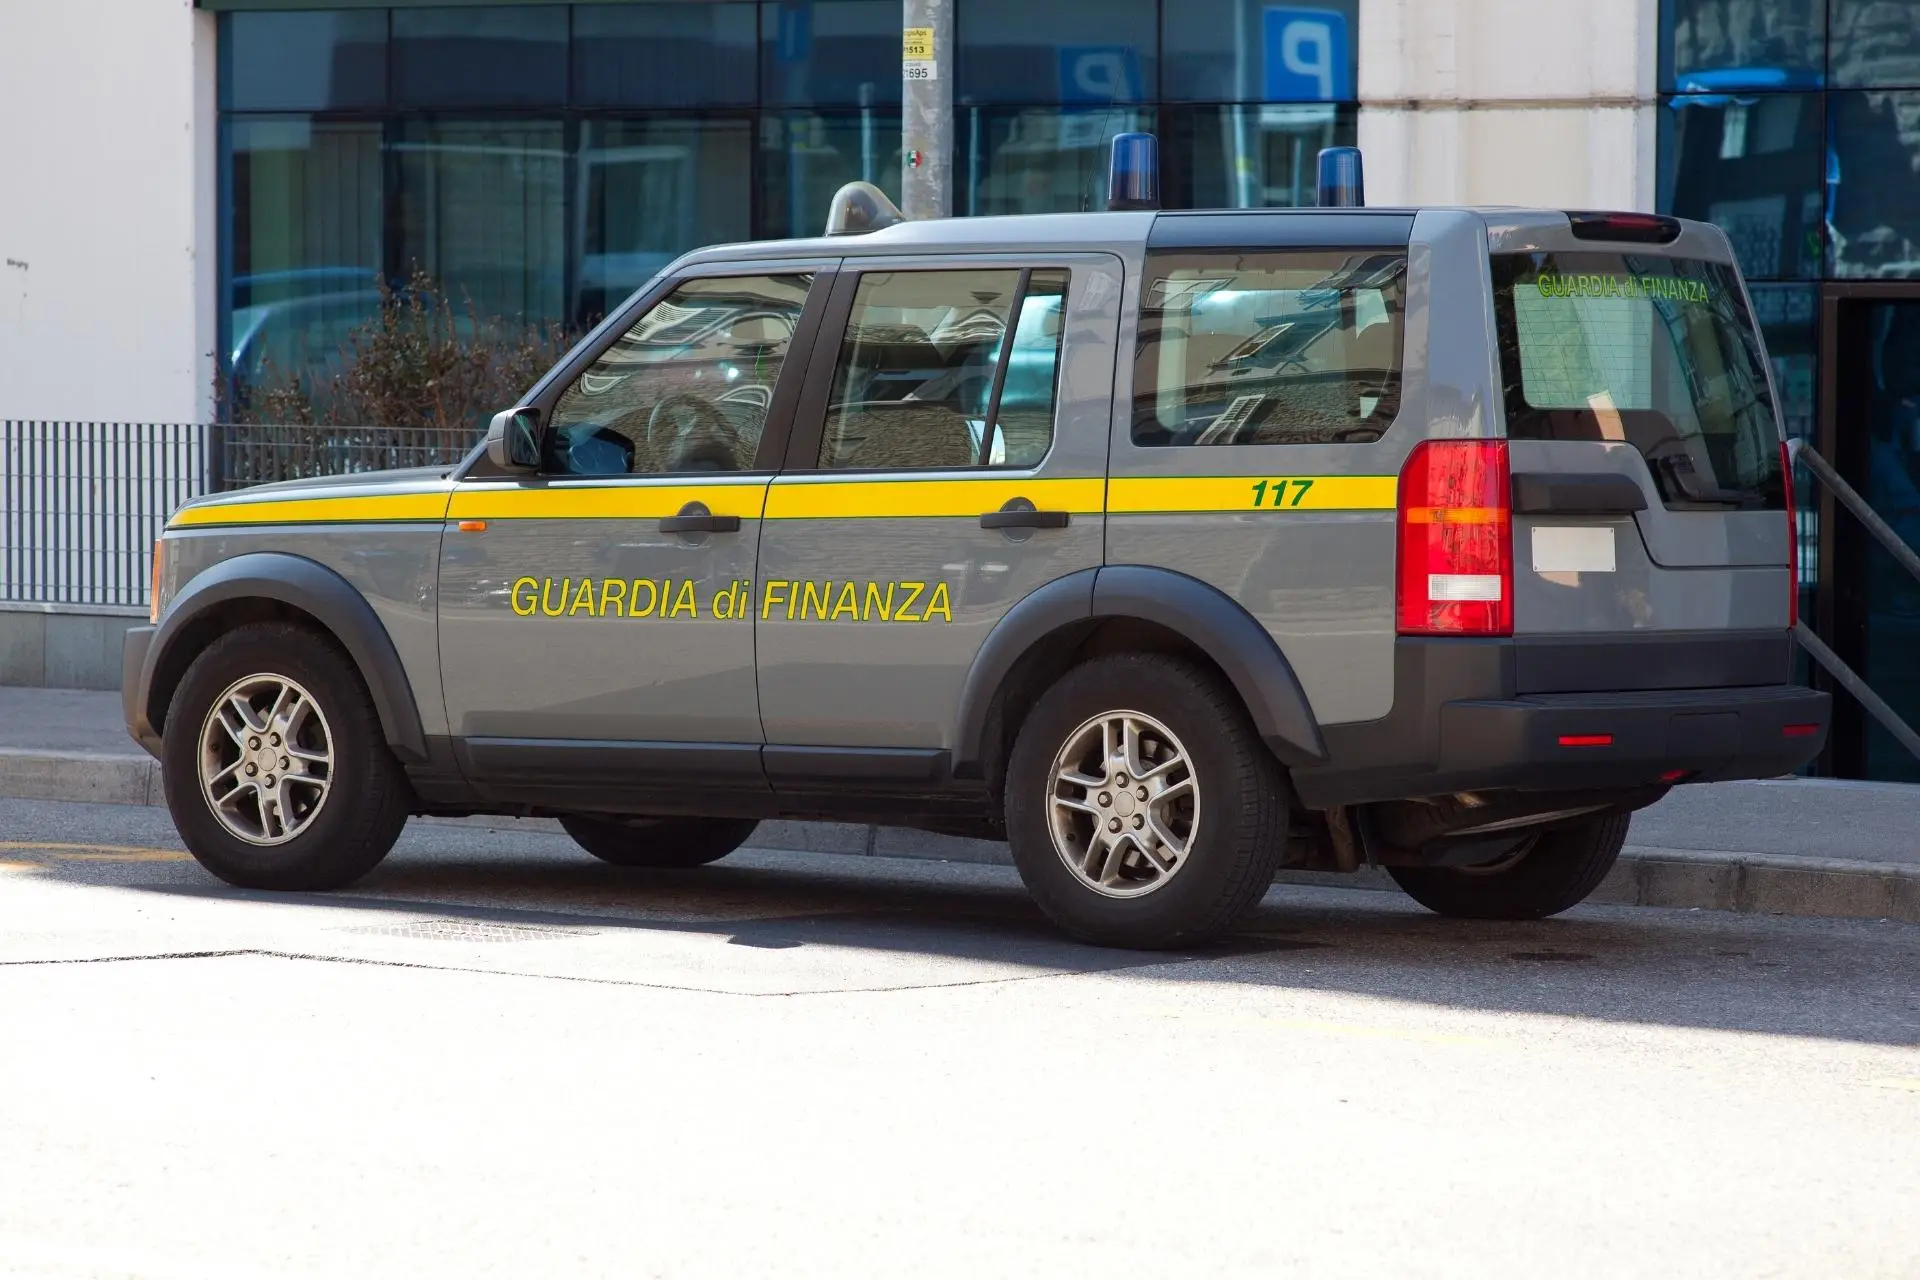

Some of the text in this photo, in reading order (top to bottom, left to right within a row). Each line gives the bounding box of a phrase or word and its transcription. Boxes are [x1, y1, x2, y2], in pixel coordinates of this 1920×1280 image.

[1537, 274, 1709, 303] GUARDIA di FINANZA
[1251, 480, 1314, 506] 117
[510, 576, 953, 622] GUARDIA di FINANZA
